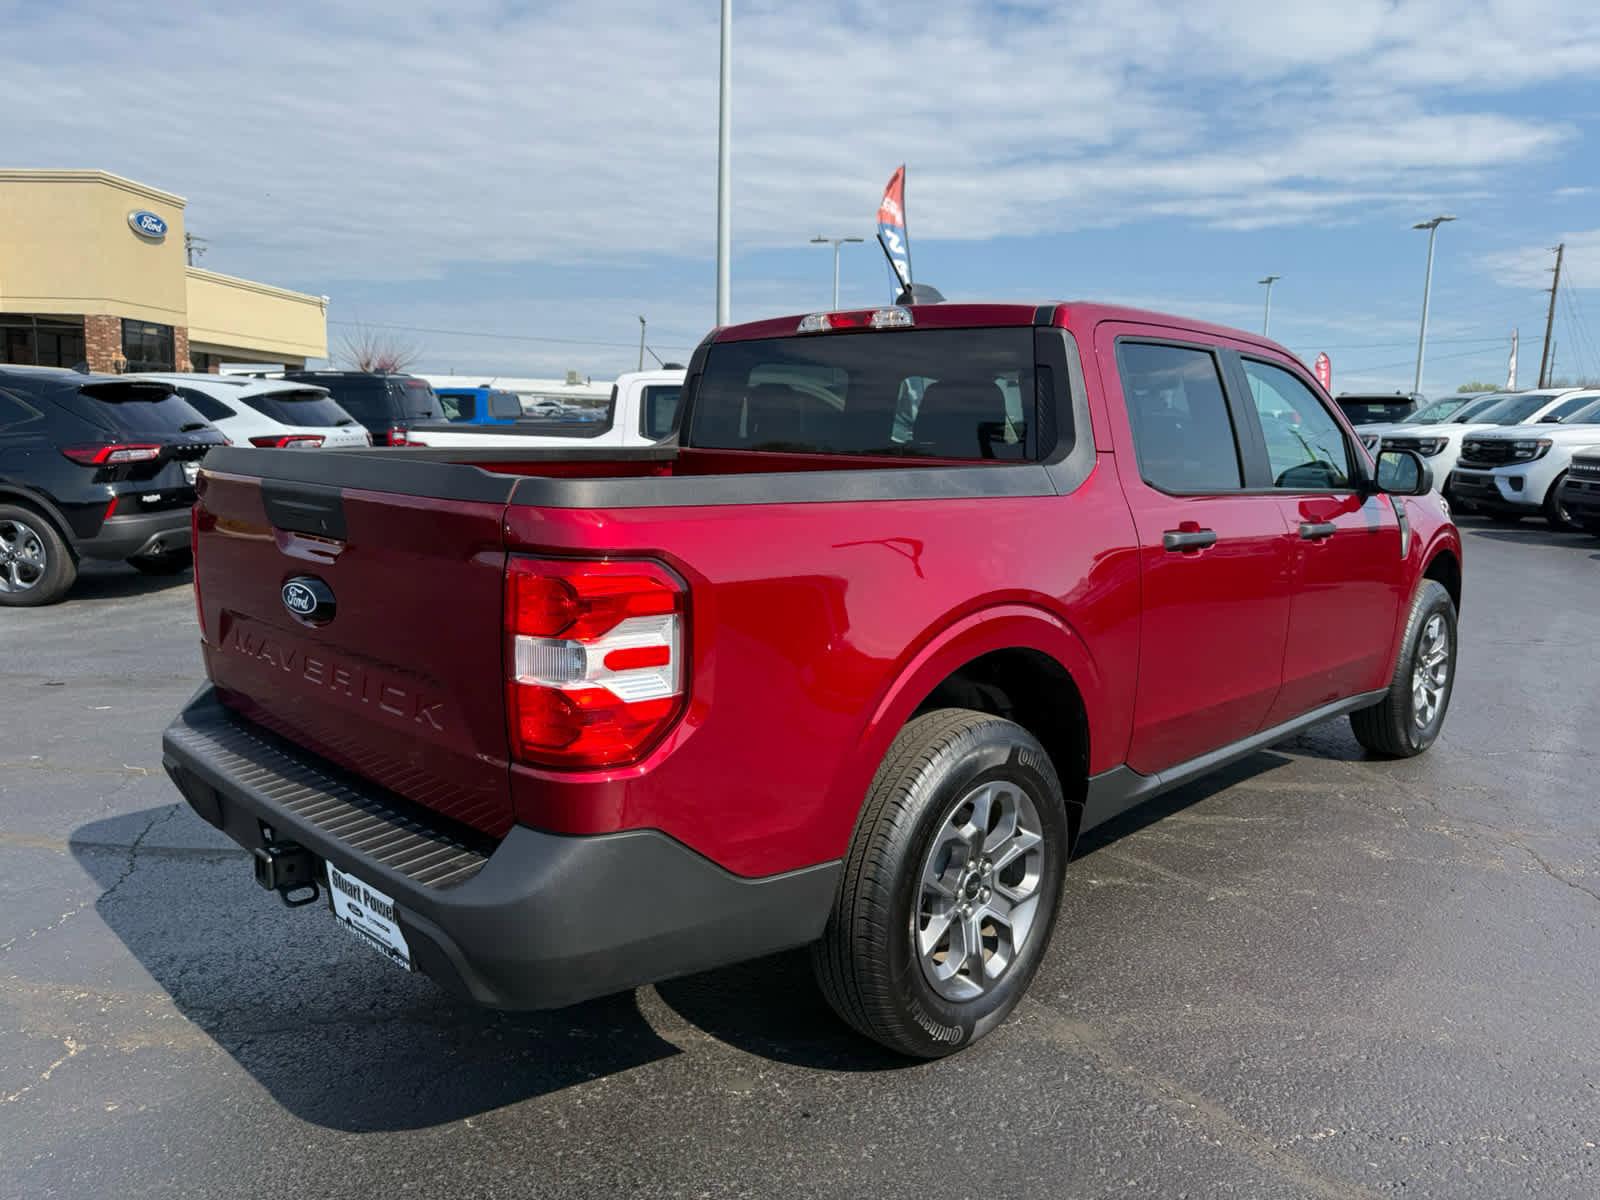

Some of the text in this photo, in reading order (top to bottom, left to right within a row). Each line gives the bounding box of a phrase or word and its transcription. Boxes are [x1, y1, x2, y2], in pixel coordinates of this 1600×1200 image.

[141, 215, 162, 233] Ford
[286, 585, 311, 611] Ford
[232, 627, 444, 731] MAVERICK
[332, 869, 362, 905] Stuart
